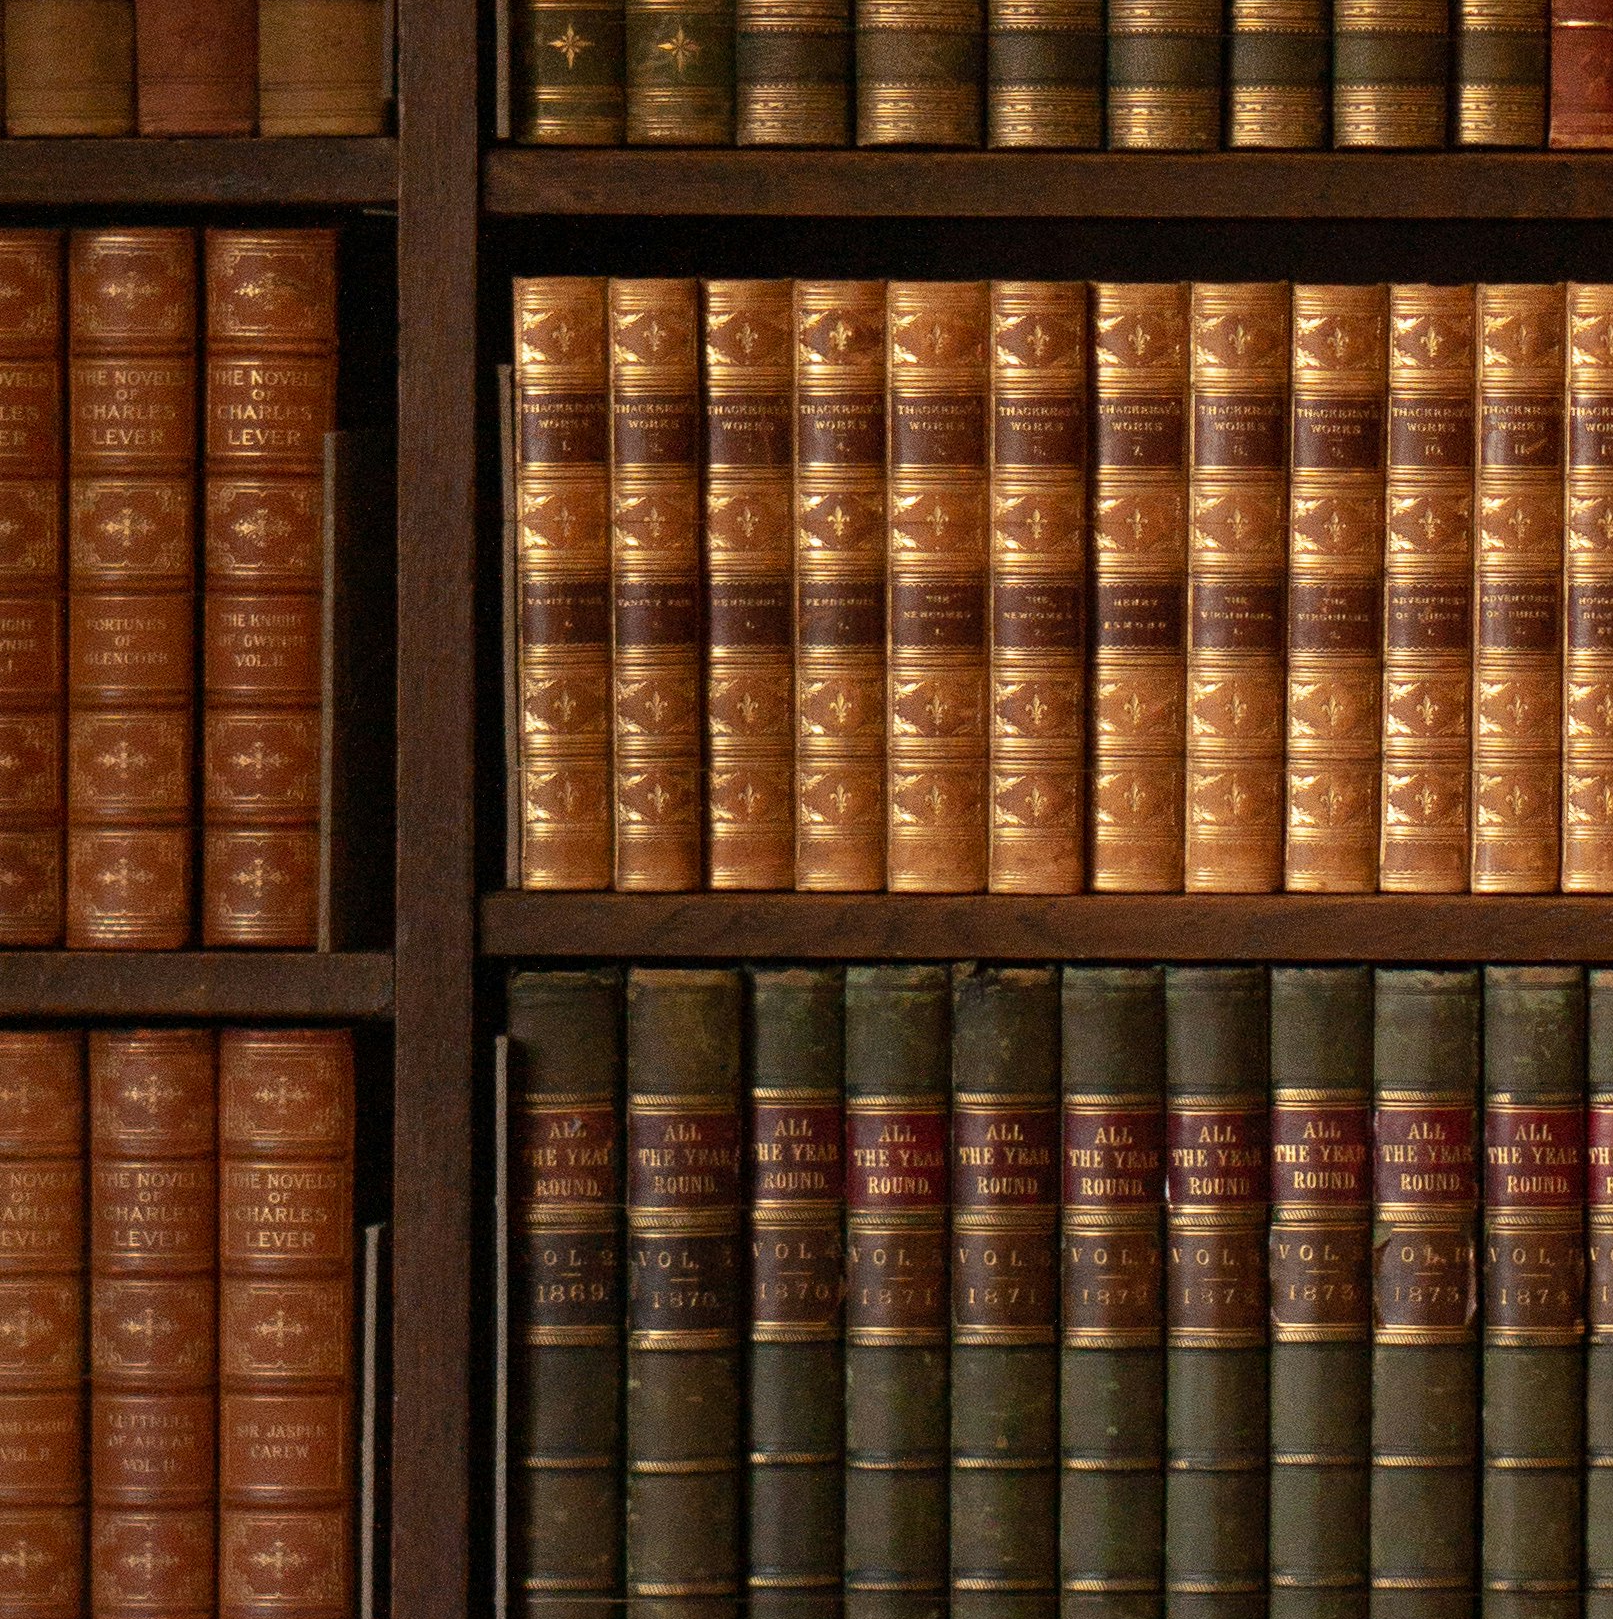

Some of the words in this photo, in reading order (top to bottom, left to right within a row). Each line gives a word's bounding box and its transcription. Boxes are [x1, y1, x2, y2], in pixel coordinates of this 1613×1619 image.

[115, 388, 137, 401] OF
[252, 388, 274, 401] OF
[82, 405, 175, 421] CHARLES
[217, 405, 312, 421] CHARLES
[1111, 421, 1163, 432] WORKS
[93, 429, 164, 446] LEVER
[228, 429, 300, 446] LEVER
[549, 1121, 586, 1139] ALL
[664, 1124, 701, 1142] ALL
[774, 1119, 812, 1137] ALL
[878, 1124, 916, 1143] ALL
[986, 1123, 1024, 1141] ALL
[1095, 1127, 1132, 1145] ALL
[1199, 1125, 1236, 1143] ALL
[1303, 1121, 1341, 1139] ALL
[1408, 1122, 1445, 1140] ALL
[1515, 1123, 1552, 1141] ALL
[639, 1148, 679, 1167] THE
[686, 1148, 732, 1166] YEAR
[792, 1143, 838, 1161] YEAR
[854, 1149, 889, 1167] THE
[899, 1148, 943, 1167] YEAR
[959, 1147, 994, 1165] THE
[1005, 1147, 1050, 1165] YEAR
[1070, 1149, 1104, 1168] THE
[1114, 1150, 1158, 1169] YEAR
[1173, 1149, 1208, 1167] THE
[1218, 1150, 1264, 1168] YEAR
[1274, 1144, 1310, 1162] THE
[1321, 1144, 1366, 1163] YEAR
[1382, 1144, 1417, 1162] THE
[1428, 1145, 1472, 1162] YEAR
[1487, 1147, 1522, 1165] THE
[1532, 1147, 1577, 1164] YEAR
[267, 1173, 338, 1190] NOVELS
[536, 1179, 601, 1197] ROUND.
[654, 1176, 718, 1193] ROUND.
[764, 1172, 828, 1190] ROUND.
[868, 1177, 931, 1194] ROUND.
[1401, 1174, 1464, 1191] ROUND.
[1506, 1175, 1570, 1193] ROUND.
[139, 1191, 161, 1204] OF
[268, 1191, 292, 1205] OF
[235, 1207, 328, 1224] CHARLES
[115, 1232, 190, 1248] LEVER
[245, 1231, 316, 1248] LEVER
